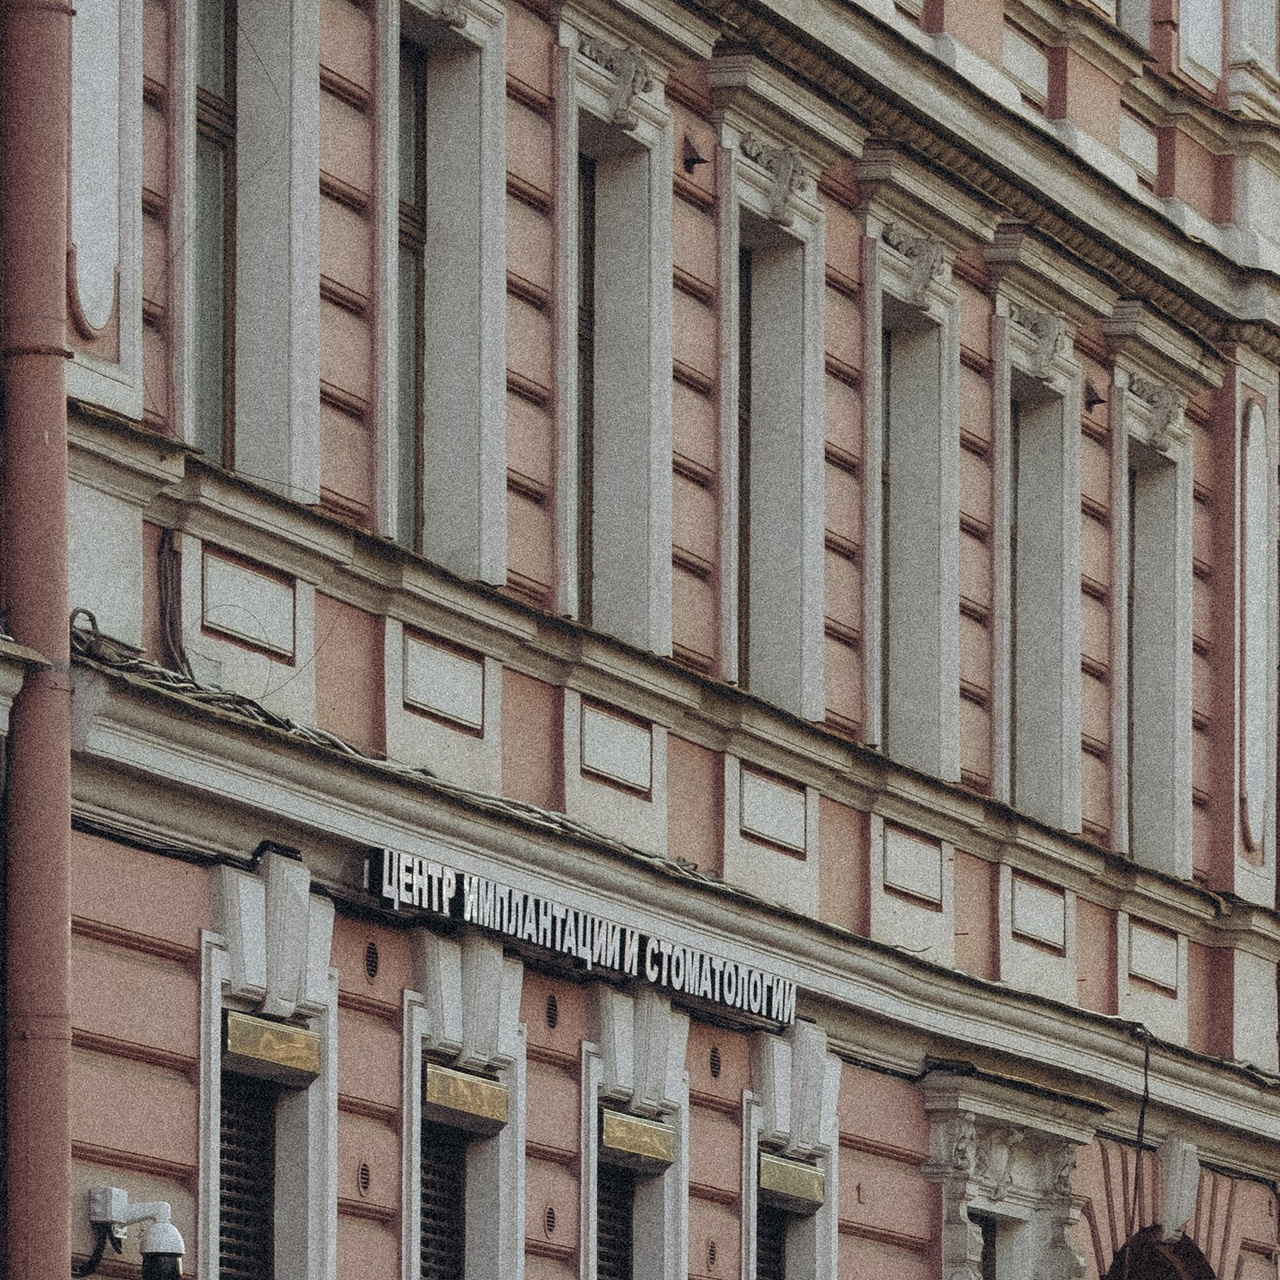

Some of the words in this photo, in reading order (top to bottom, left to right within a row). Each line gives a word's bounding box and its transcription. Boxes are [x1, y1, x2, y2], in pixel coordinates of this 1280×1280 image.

[382, 849, 457, 917] ЦЕНТР
[463, 873, 621, 971] ИМПЛАНТАЦИИ
[624, 930, 640, 976] И
[645, 935, 797, 1026] СТОМАТОЛОГИИ
